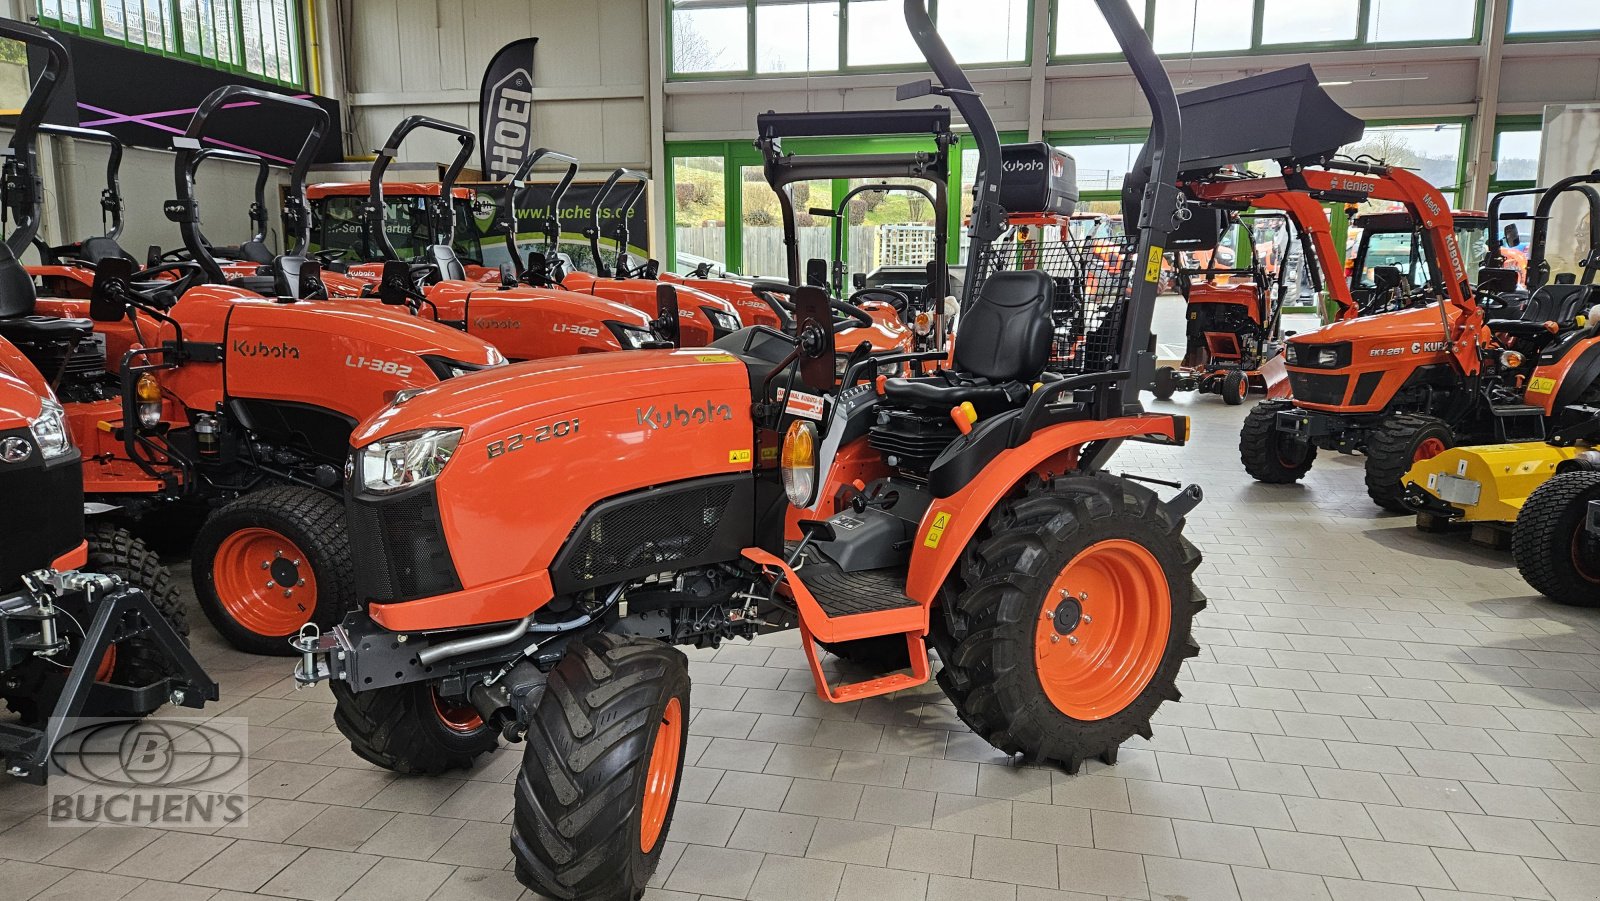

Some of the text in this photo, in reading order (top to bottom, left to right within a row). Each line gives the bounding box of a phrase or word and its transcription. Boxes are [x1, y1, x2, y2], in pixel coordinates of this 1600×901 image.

[1003, 159, 1044, 172] Kubota
[1342, 178, 1375, 193] tenias
[513, 205, 635, 220] ww.uches.e
[1445, 233, 1464, 280] KUBOTA
[473, 317, 521, 330] Kubota
[552, 323, 600, 337] L1-382
[233, 339, 300, 359] Kubota
[345, 354, 413, 378] L1-382
[636, 400, 733, 430] Kubota
[486, 417, 580, 460] B2-201
